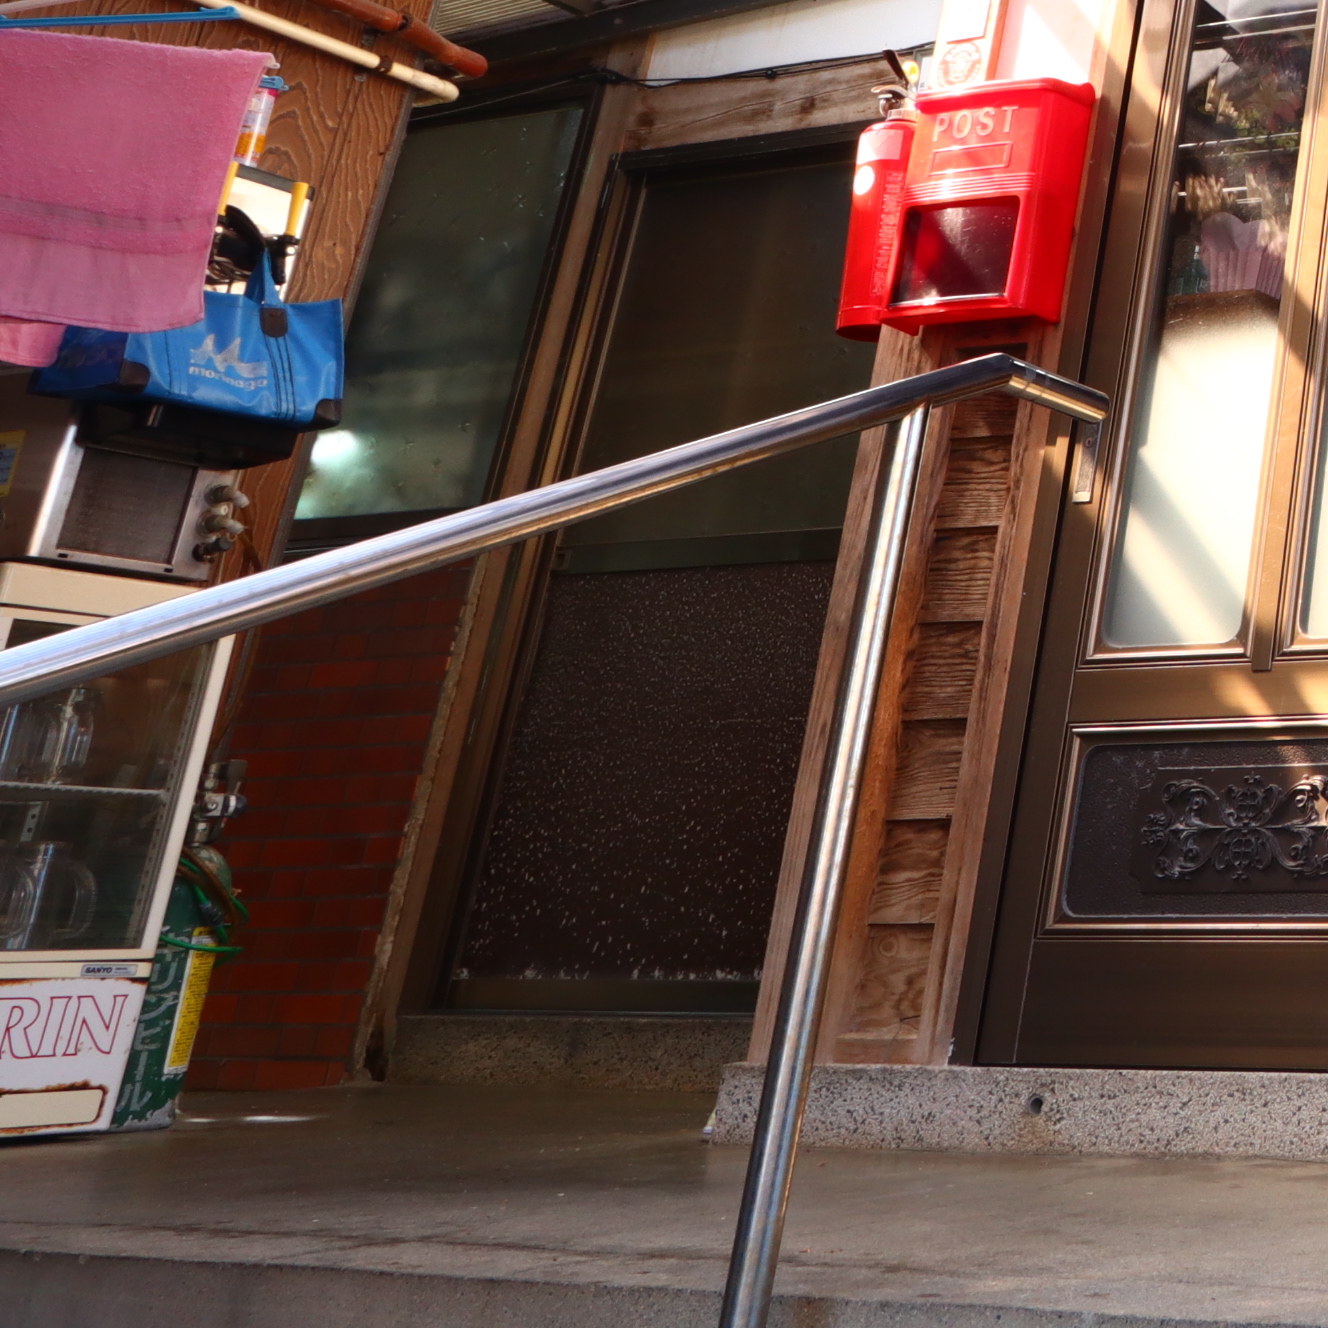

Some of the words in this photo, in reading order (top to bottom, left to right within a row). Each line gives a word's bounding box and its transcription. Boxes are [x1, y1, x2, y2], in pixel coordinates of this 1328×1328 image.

[933, 106, 1018, 142] POST
[189, 366, 268, 390] morinaga
[85, 966, 113, 974] SANYO
